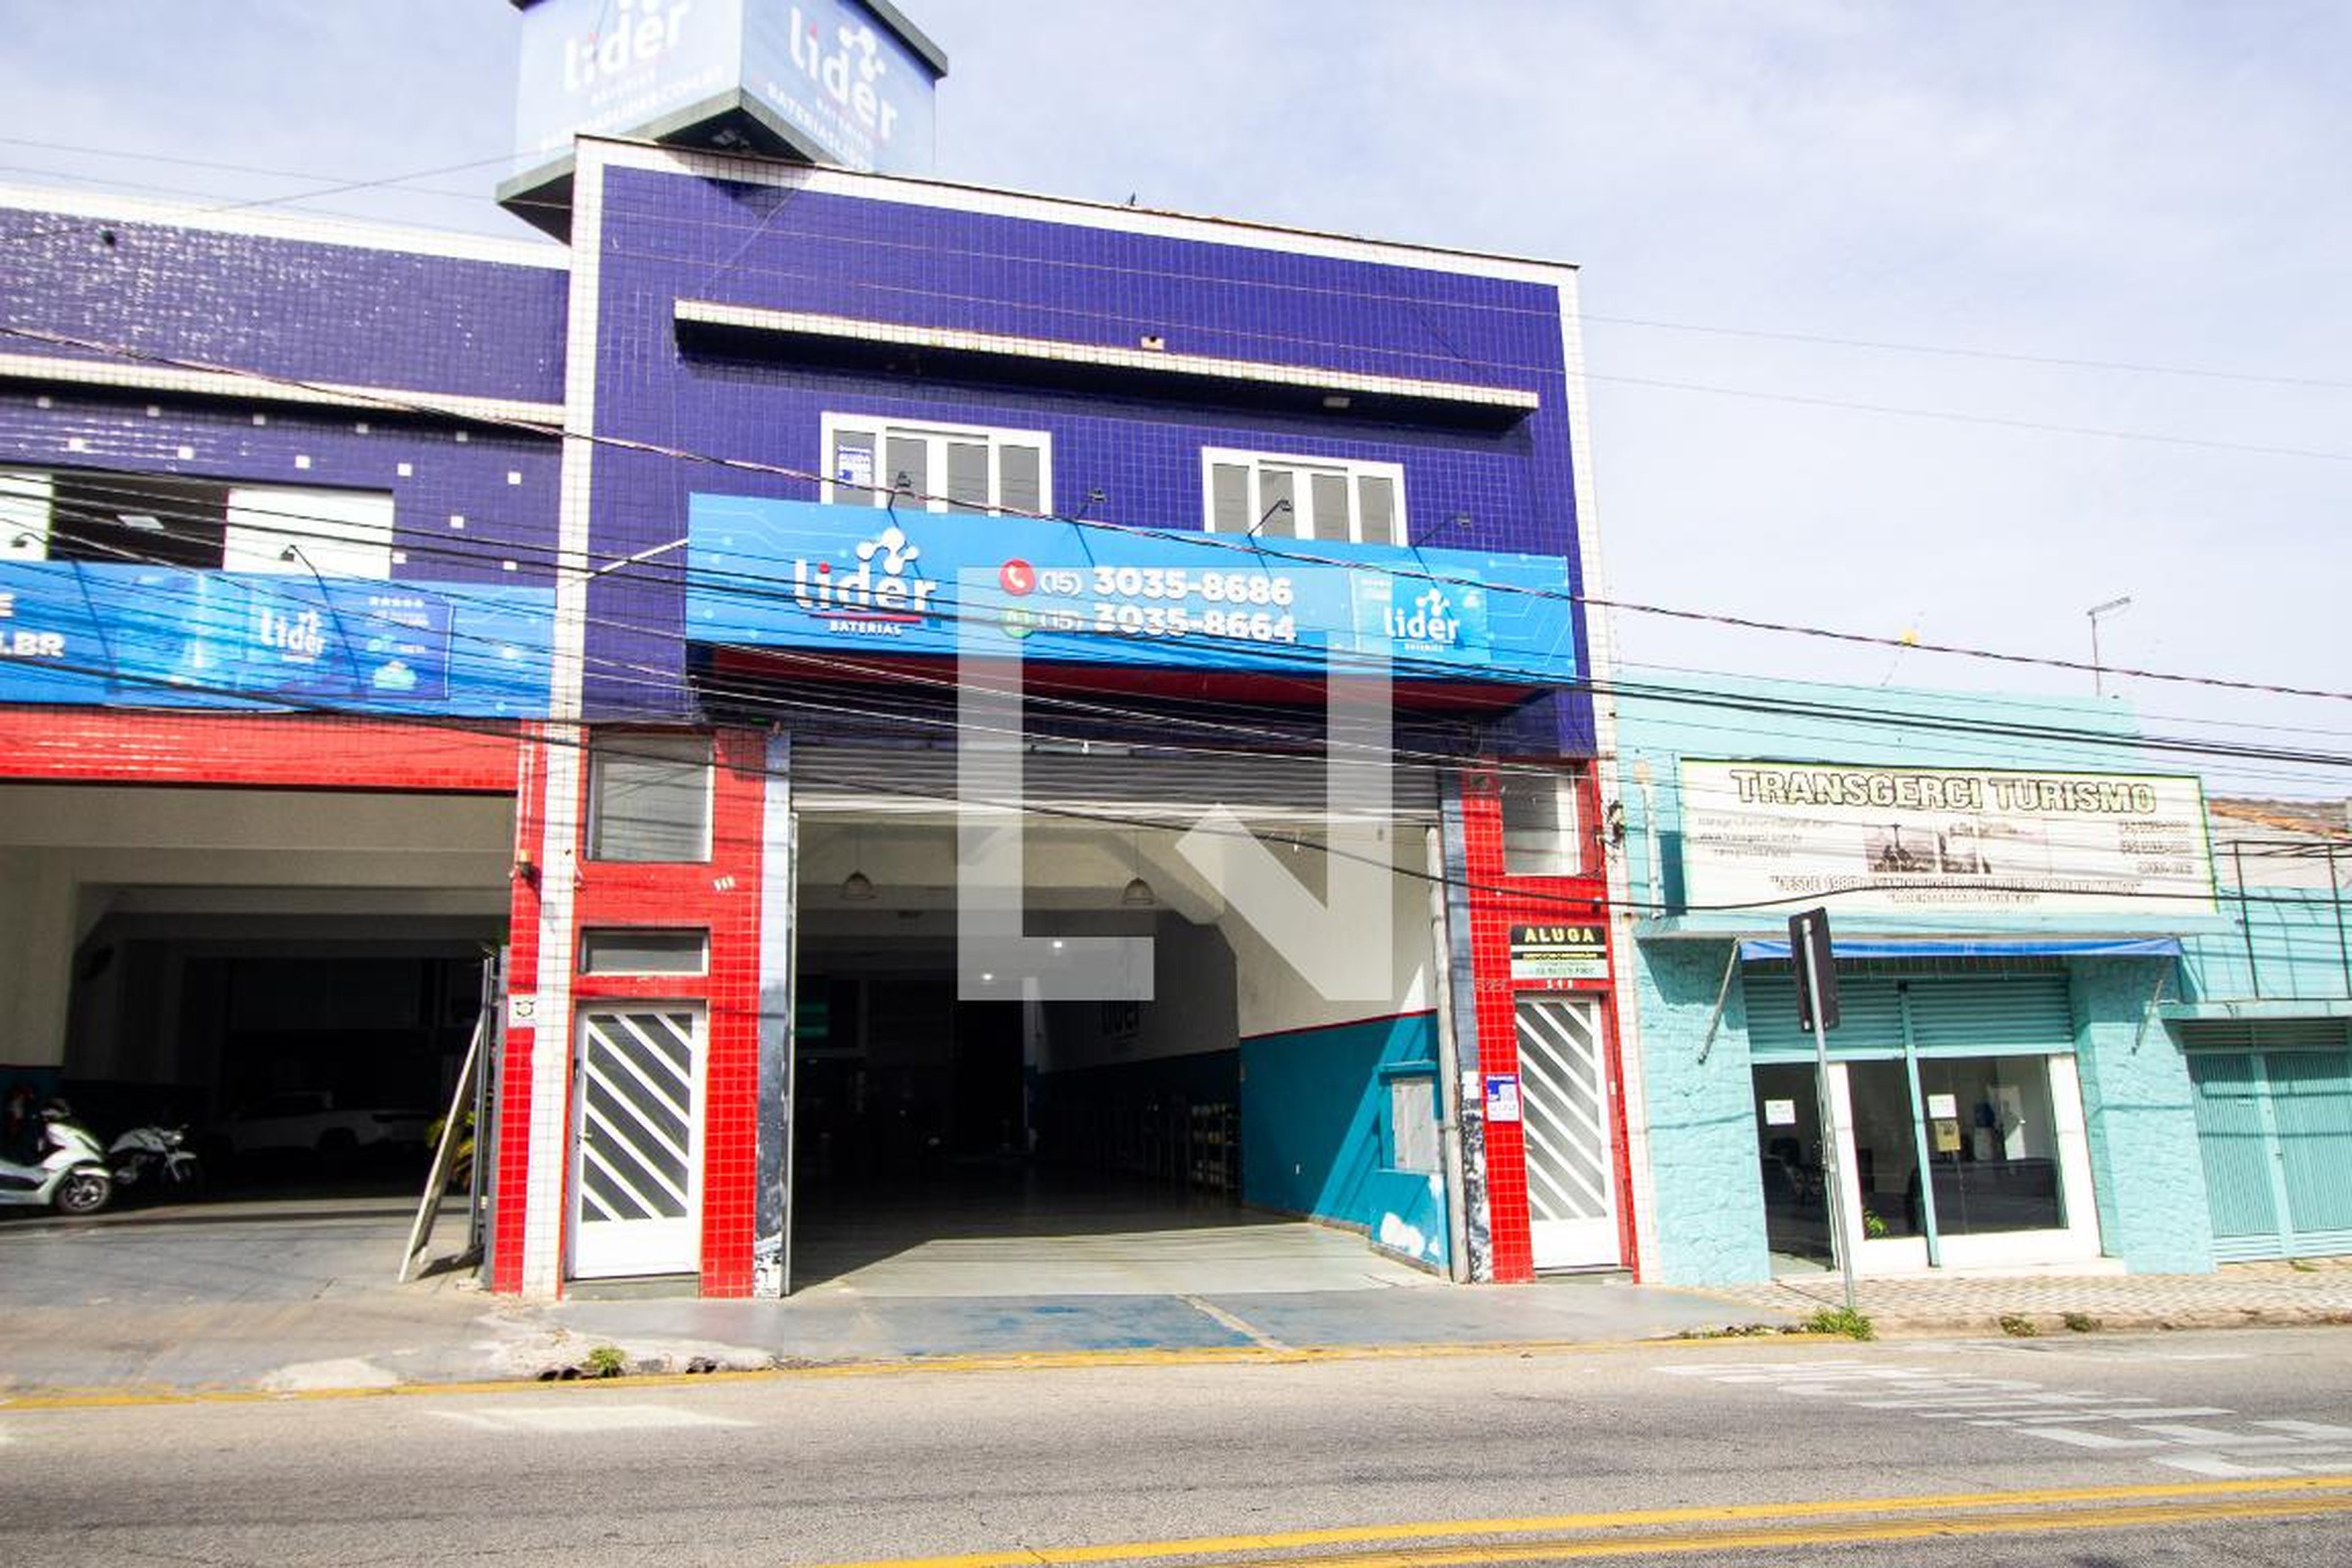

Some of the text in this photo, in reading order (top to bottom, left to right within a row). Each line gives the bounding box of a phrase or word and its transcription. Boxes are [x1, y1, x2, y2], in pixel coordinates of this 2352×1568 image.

[1039, 566, 1294, 605] (15) 3035-8686
[829, 620, 902, 636] BATERIAS
[1093, 602, 1297, 643] 3035-8664
[0, 631, 66, 658] .BR
[1989, 779, 2156, 814] TURISMO
[1525, 927, 1595, 943] ALUGA
